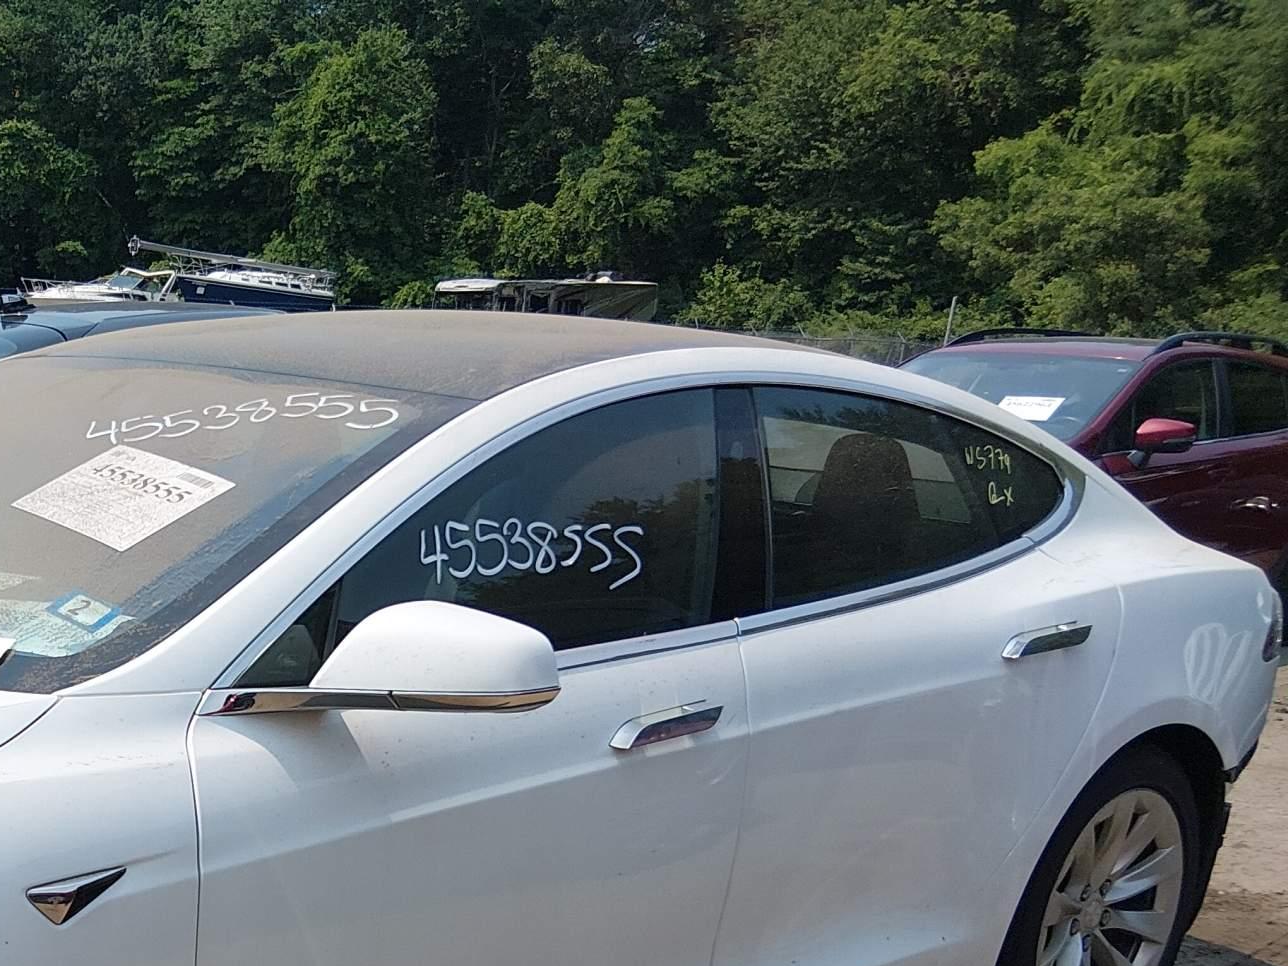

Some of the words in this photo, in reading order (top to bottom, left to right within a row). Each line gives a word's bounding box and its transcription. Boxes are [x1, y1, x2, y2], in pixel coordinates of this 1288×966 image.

[85, 392, 399, 445] 45538555
[92, 463, 193, 504] 45538555
[420, 517, 644, 590] 45538555
[67, 599, 92, 616] 2
